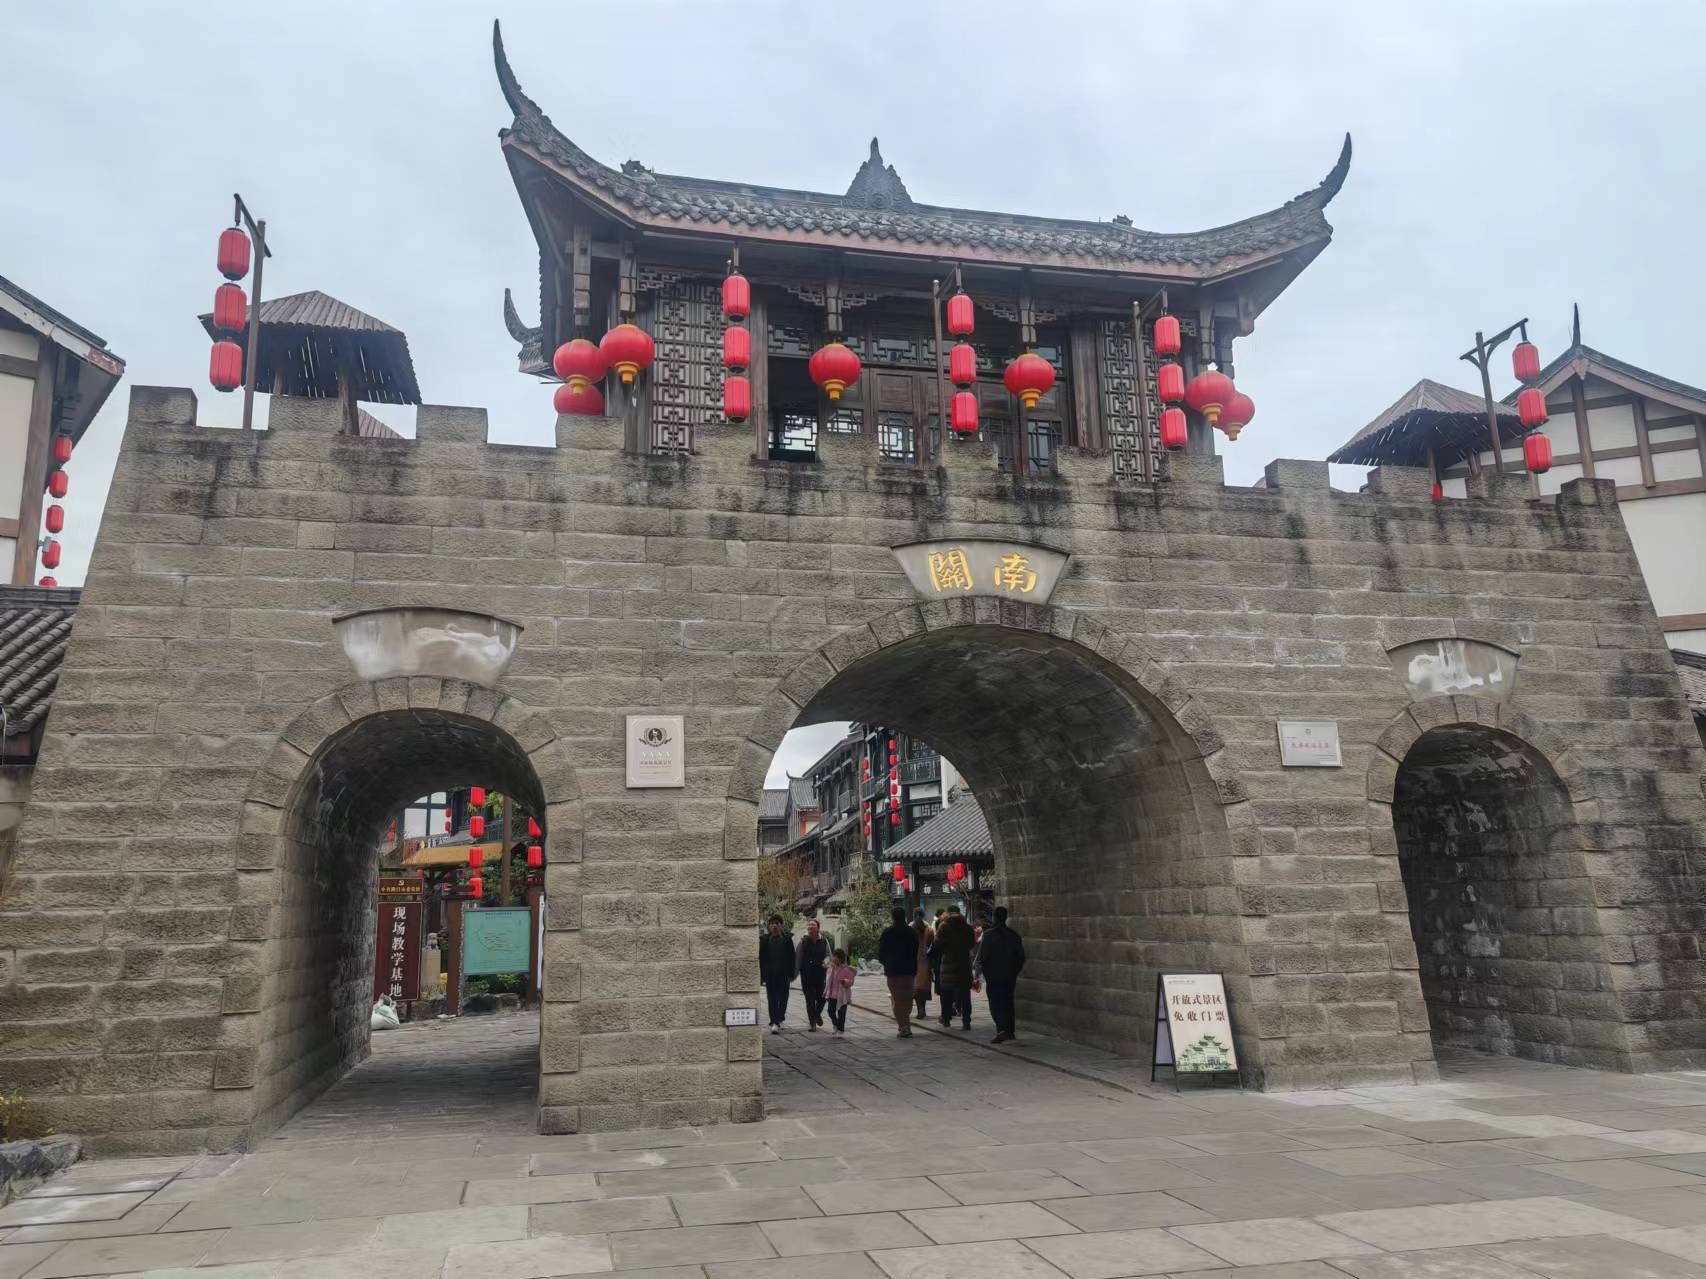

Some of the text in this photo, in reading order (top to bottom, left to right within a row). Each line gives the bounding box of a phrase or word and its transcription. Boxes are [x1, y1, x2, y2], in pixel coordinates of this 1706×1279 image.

[389, 906, 407, 997] 现场教学基地
[1172, 994, 1223, 1005] 开放式景区
[1174, 1011, 1225, 1022] 免收门票
